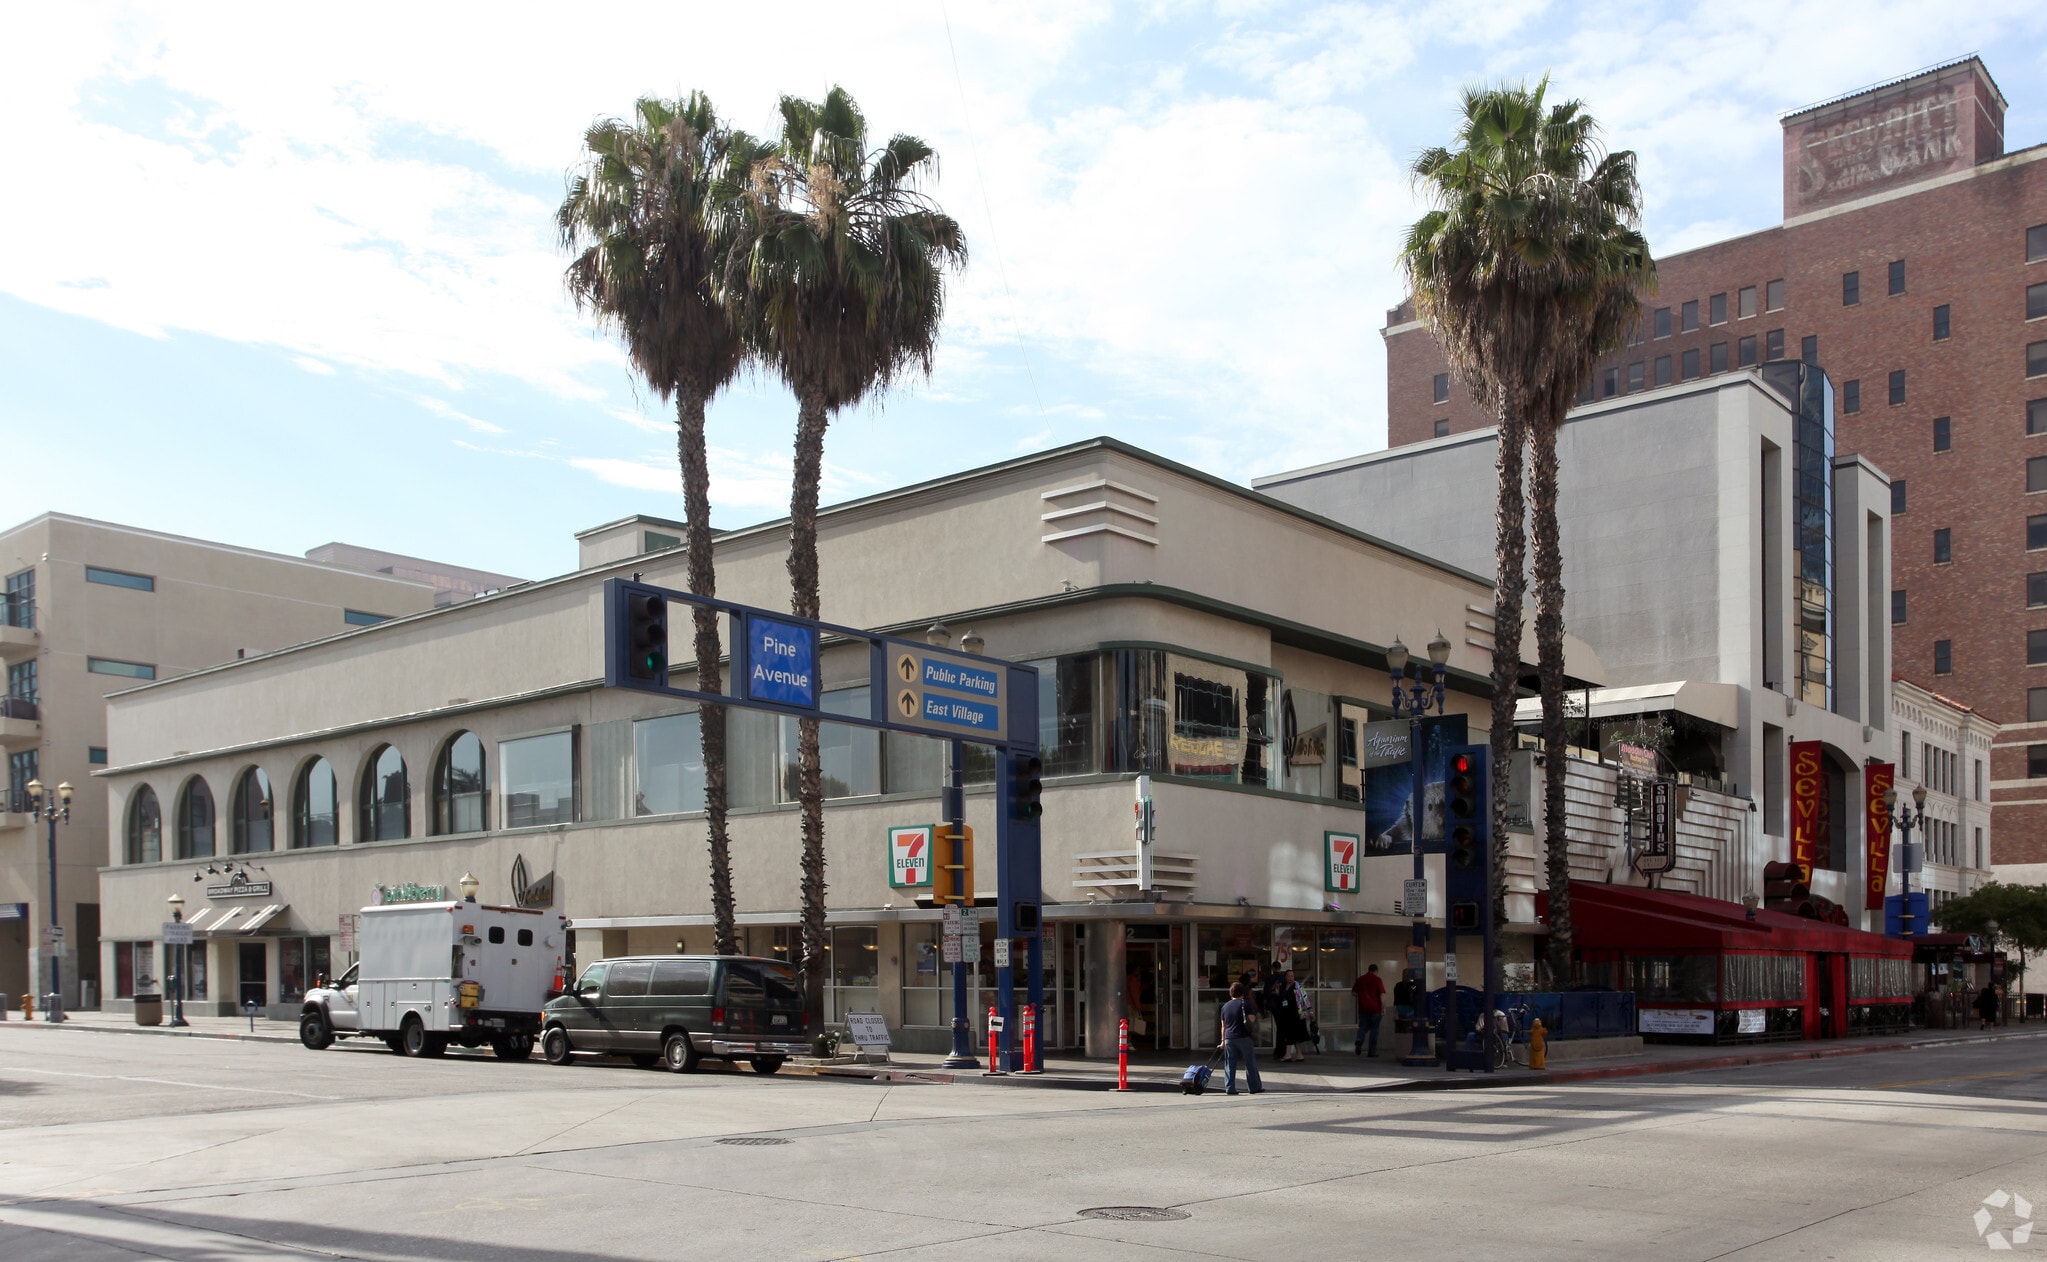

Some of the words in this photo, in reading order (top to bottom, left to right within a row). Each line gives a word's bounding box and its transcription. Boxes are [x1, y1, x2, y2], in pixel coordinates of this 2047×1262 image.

[764, 636, 796, 657] Pine
[753, 664, 808, 687] Avenue
[926, 666, 956, 684] Public
[959, 672, 995, 694] Parking
[926, 700, 948, 717] East
[952, 705, 984, 724] Village
[1368, 731, 1407, 750] Aquarium
[1380, 744, 1406, 759] Pacific
[897, 832, 924, 884] 7
[1333, 840, 1354, 889] 7
[208, 887, 234, 895] BROADWAY
[234, 886, 248, 894] PIZZA
[385, 882, 443, 904] pinkberry
